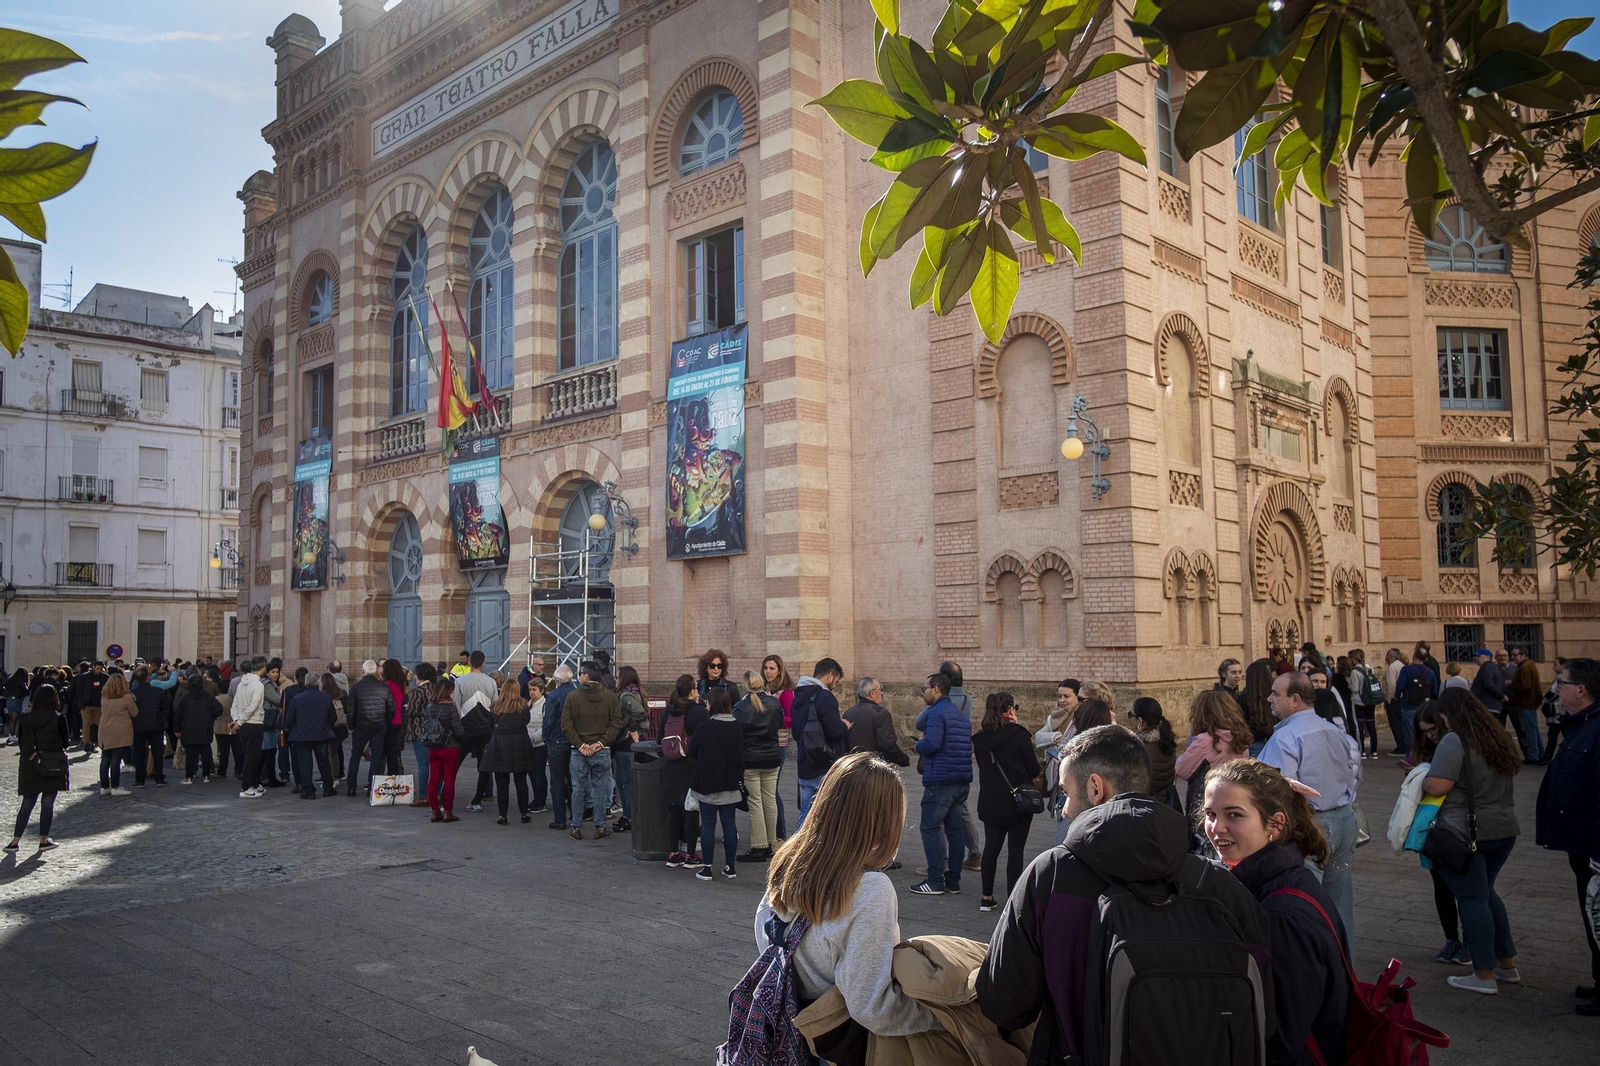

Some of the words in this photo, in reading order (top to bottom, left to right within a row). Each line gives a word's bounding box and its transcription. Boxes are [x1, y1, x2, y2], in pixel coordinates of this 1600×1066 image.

[380, 104, 426, 145] GRAN
[435, 49, 519, 113] TEATRO
[527, 0, 610, 61] FALLA
